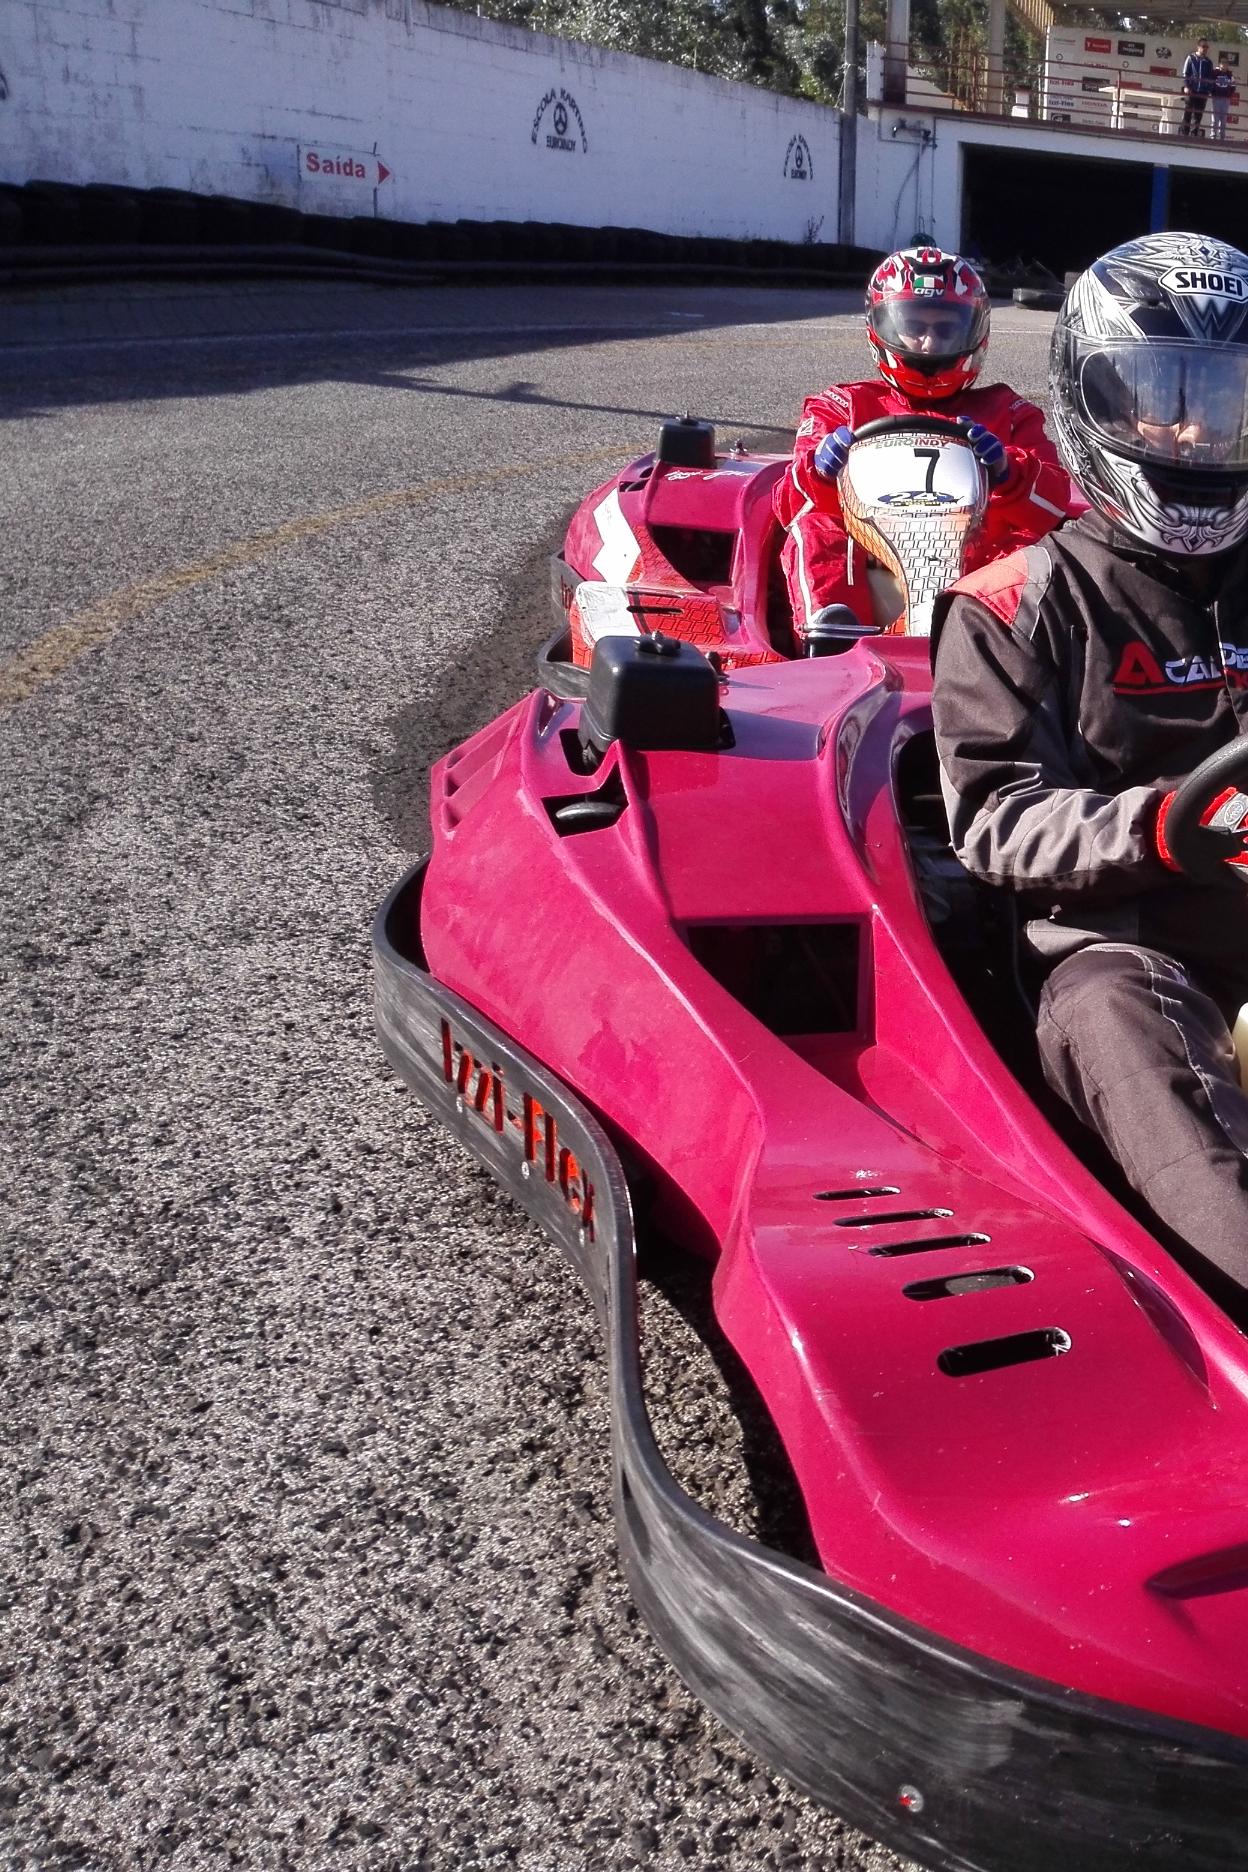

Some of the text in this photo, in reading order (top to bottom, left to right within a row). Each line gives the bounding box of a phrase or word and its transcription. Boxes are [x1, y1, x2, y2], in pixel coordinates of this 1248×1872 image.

[531, 87, 588, 153] ESCOLA KARTING
[306, 152, 366, 179] Saída
[914, 287, 945, 297] agv
[1175, 271, 1243, 297] SHOEI
[876, 437, 948, 449] EUROINDY
[913, 448, 940, 493] 7
